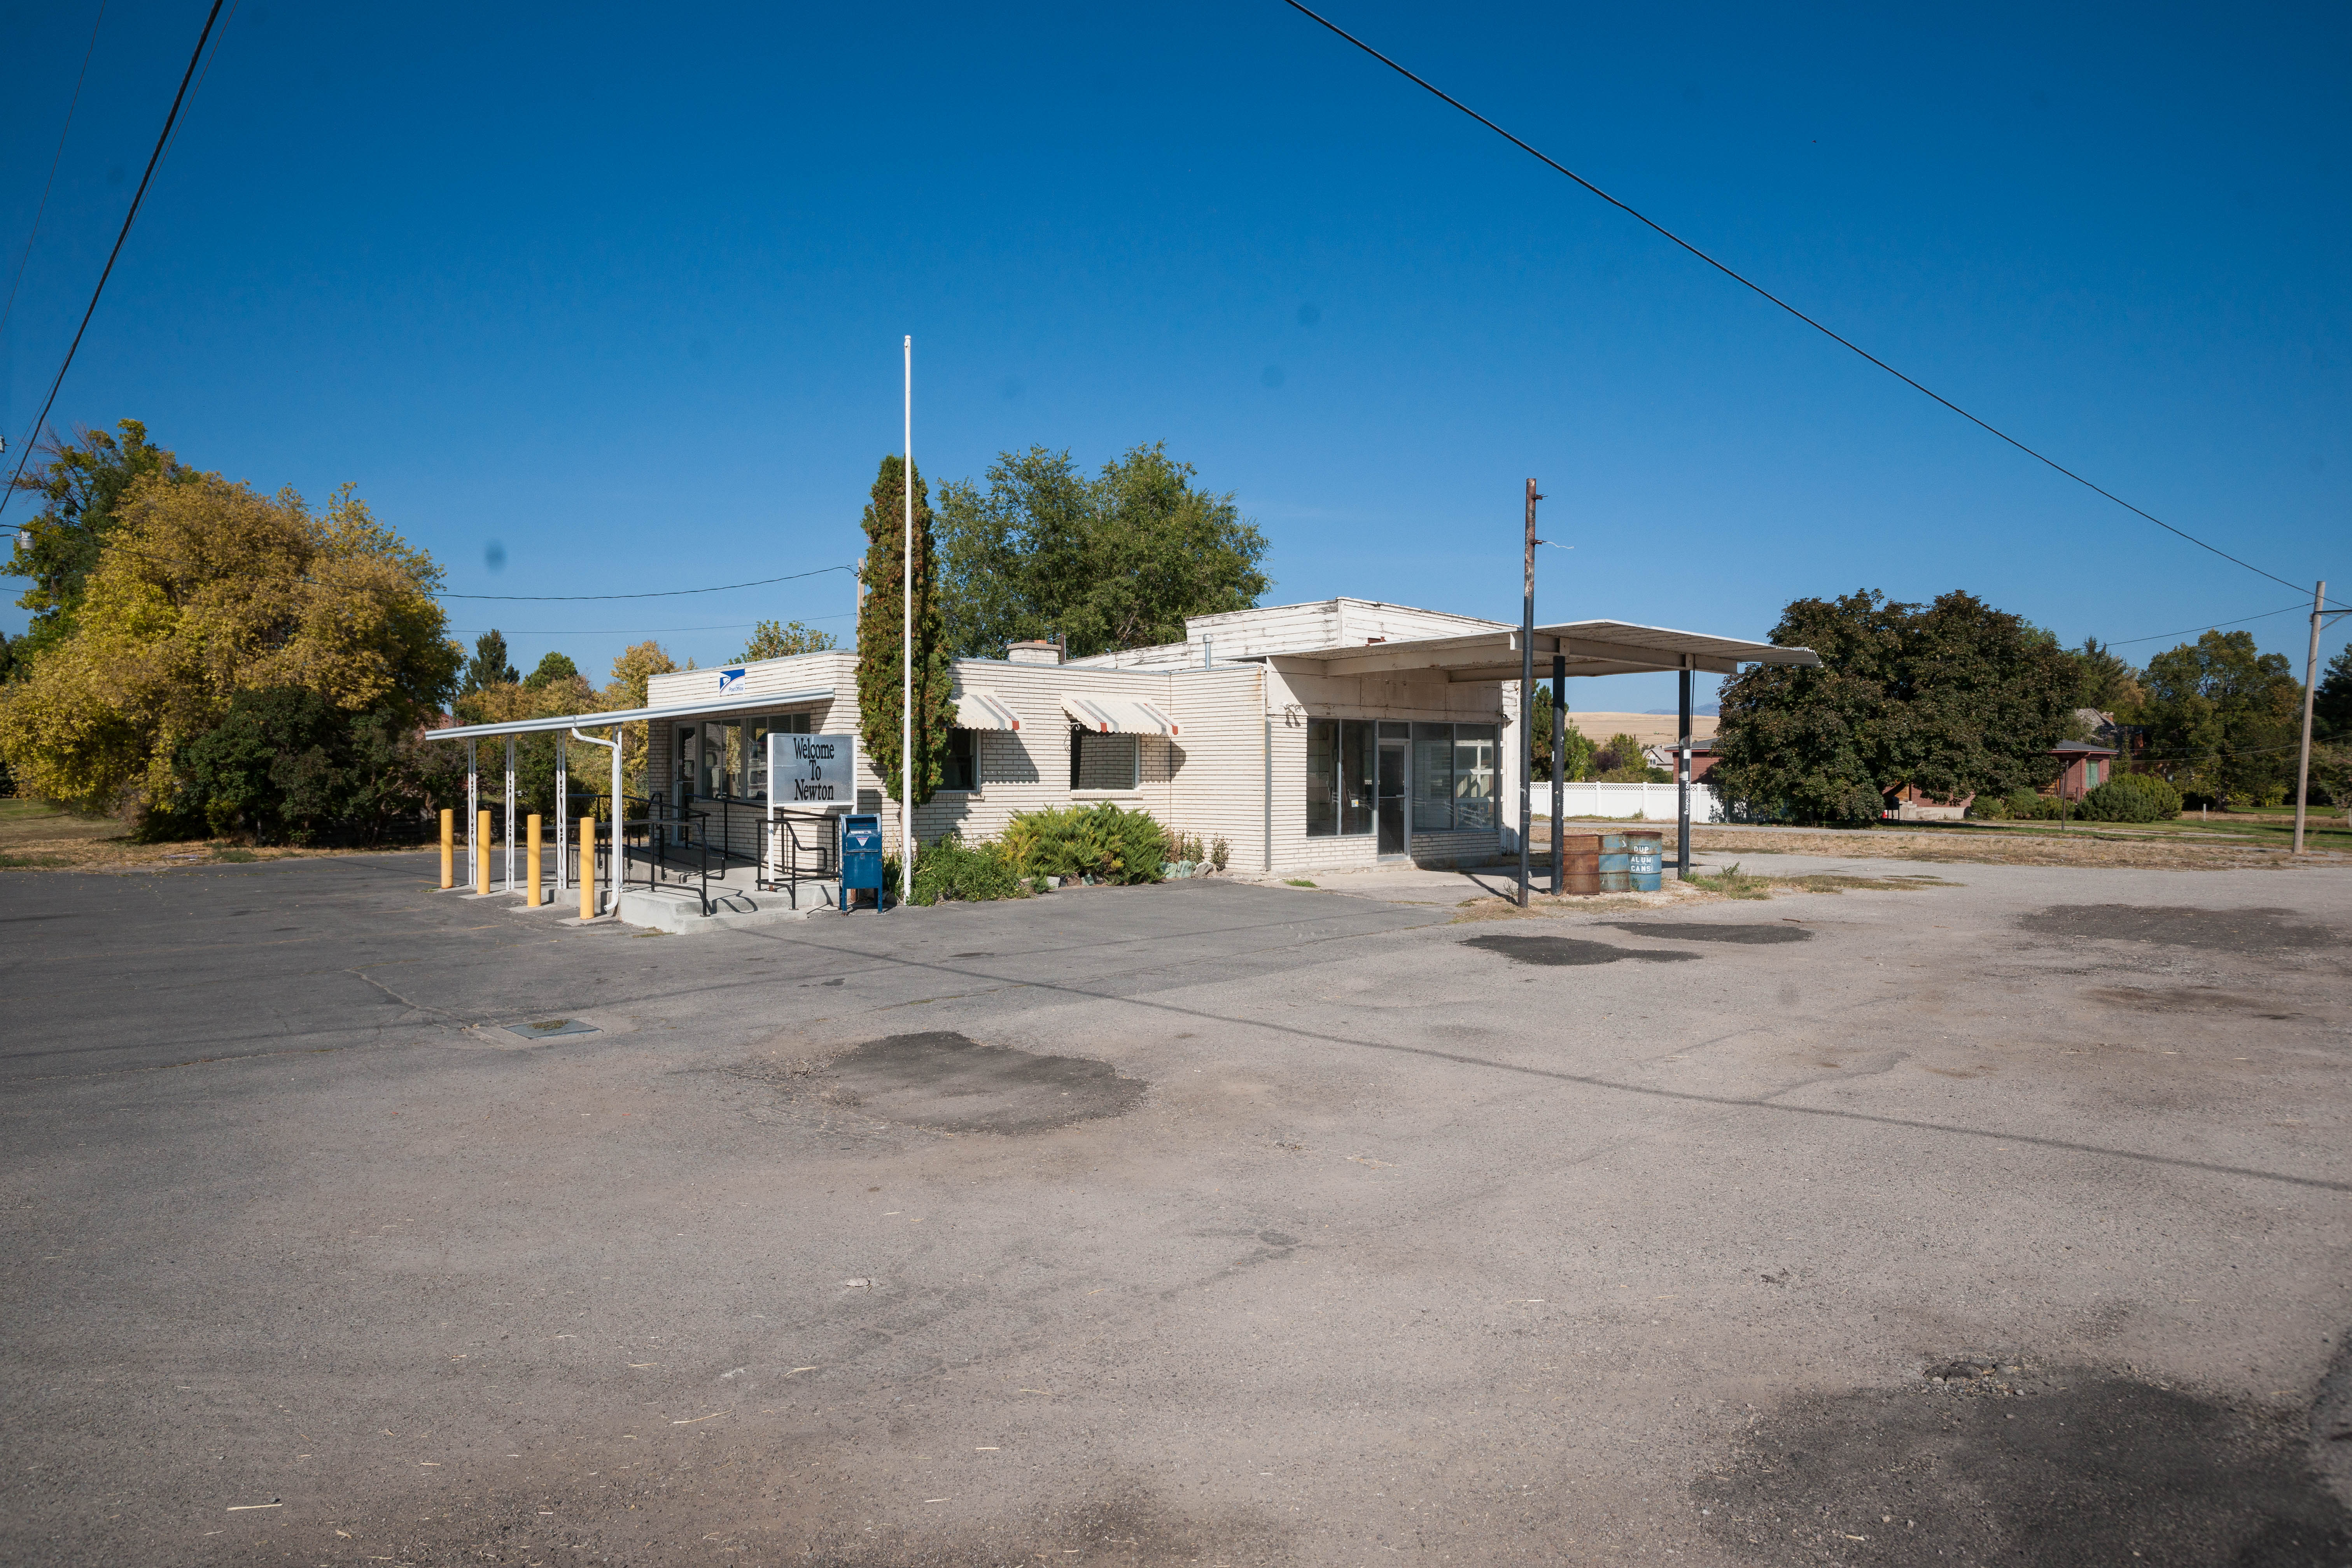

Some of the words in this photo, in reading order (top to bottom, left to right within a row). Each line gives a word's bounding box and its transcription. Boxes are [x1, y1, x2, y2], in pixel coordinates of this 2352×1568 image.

[793, 737, 835, 759] Welcome
[809, 760, 821, 781] To
[794, 779, 834, 800] Newton
[1685, 781, 1689, 789] No
